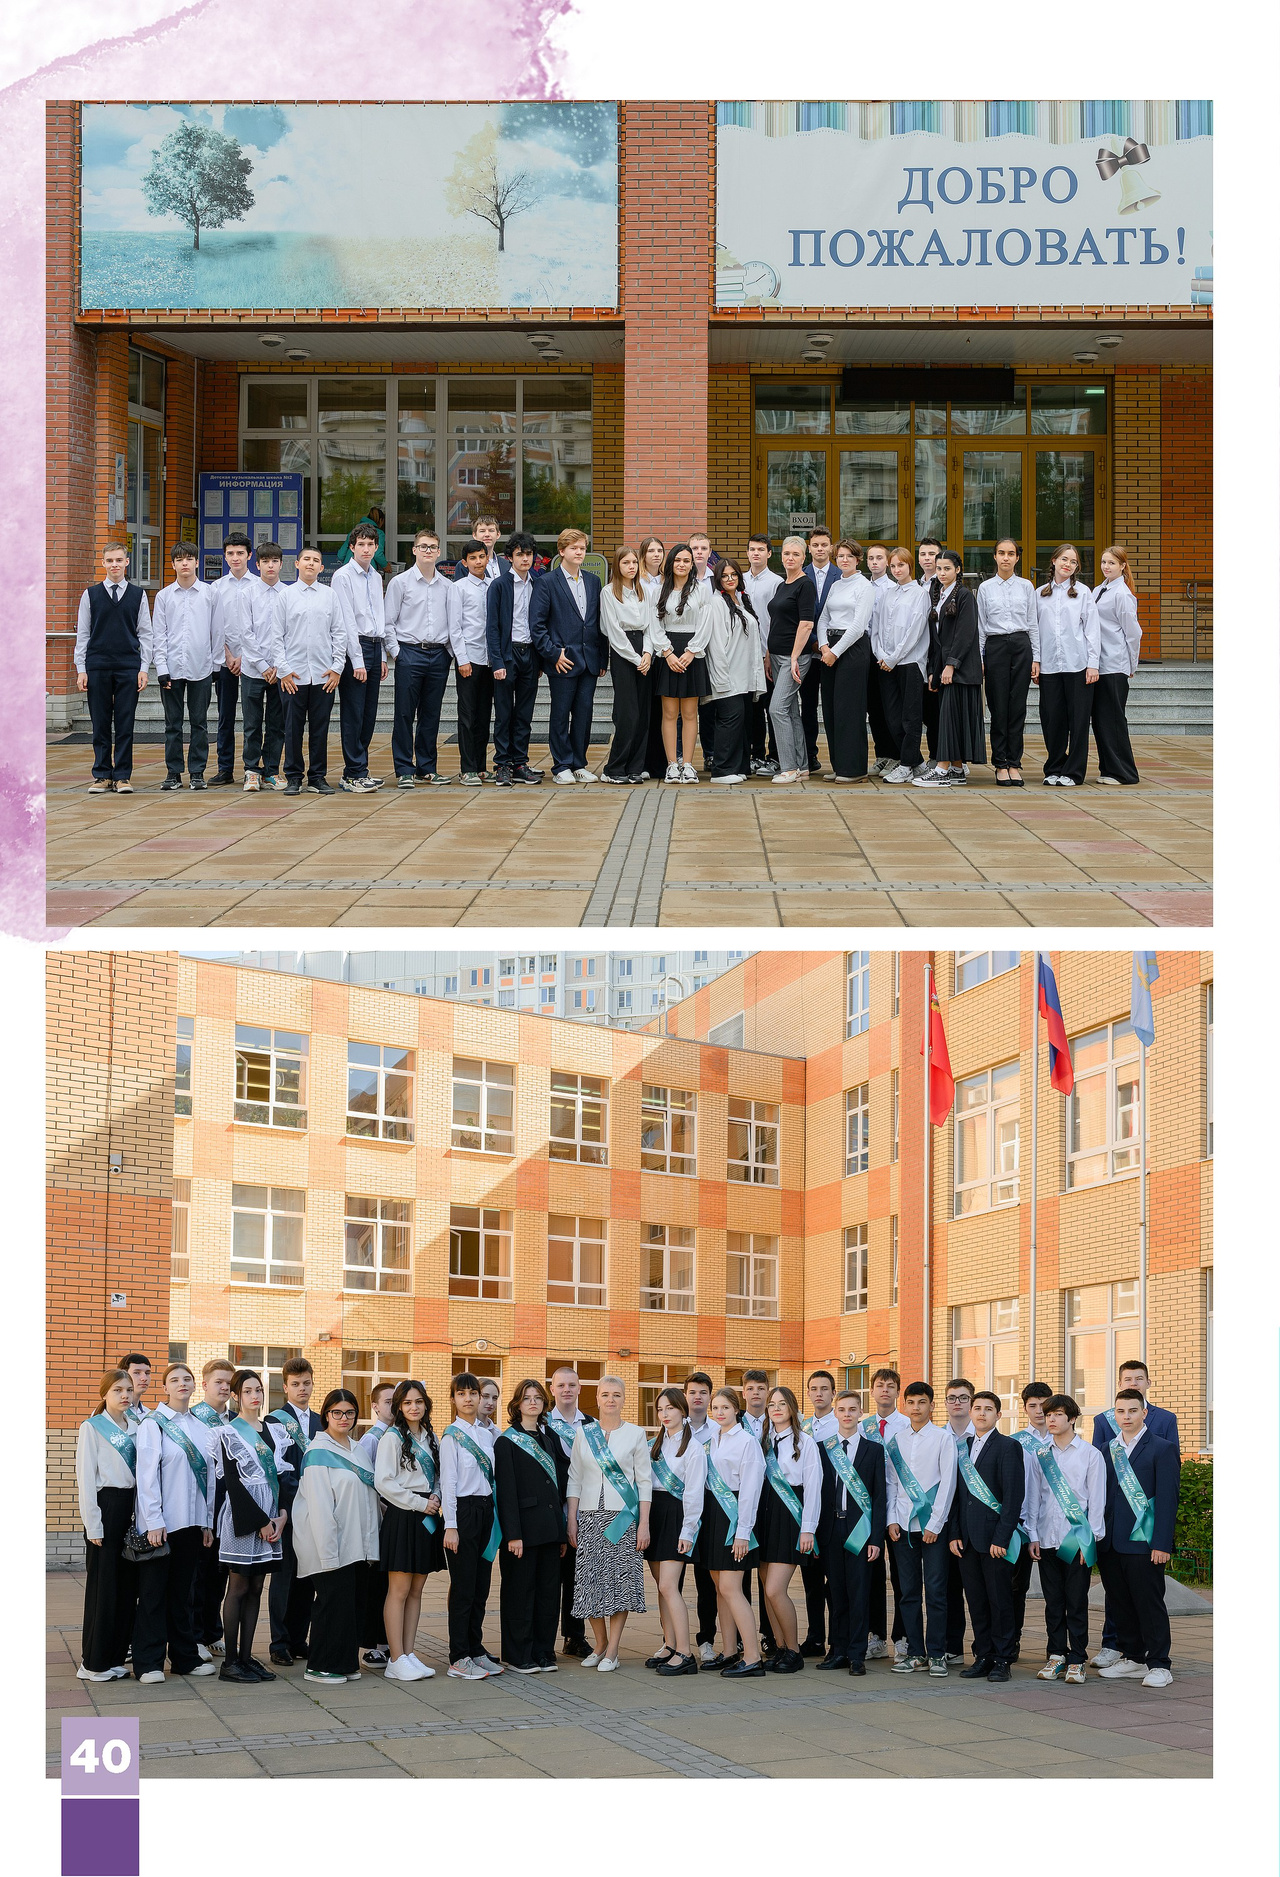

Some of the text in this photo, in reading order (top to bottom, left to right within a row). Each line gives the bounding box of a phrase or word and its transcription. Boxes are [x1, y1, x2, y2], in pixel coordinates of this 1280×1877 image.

[897, 165, 1079, 214] ДОБРО
[787, 226, 1187, 267] ПОЖАЛОВАТЬ!
[219, 480, 284, 488] ИНФОРМАЦИЯ
[792, 516, 814, 524] ВХОД
